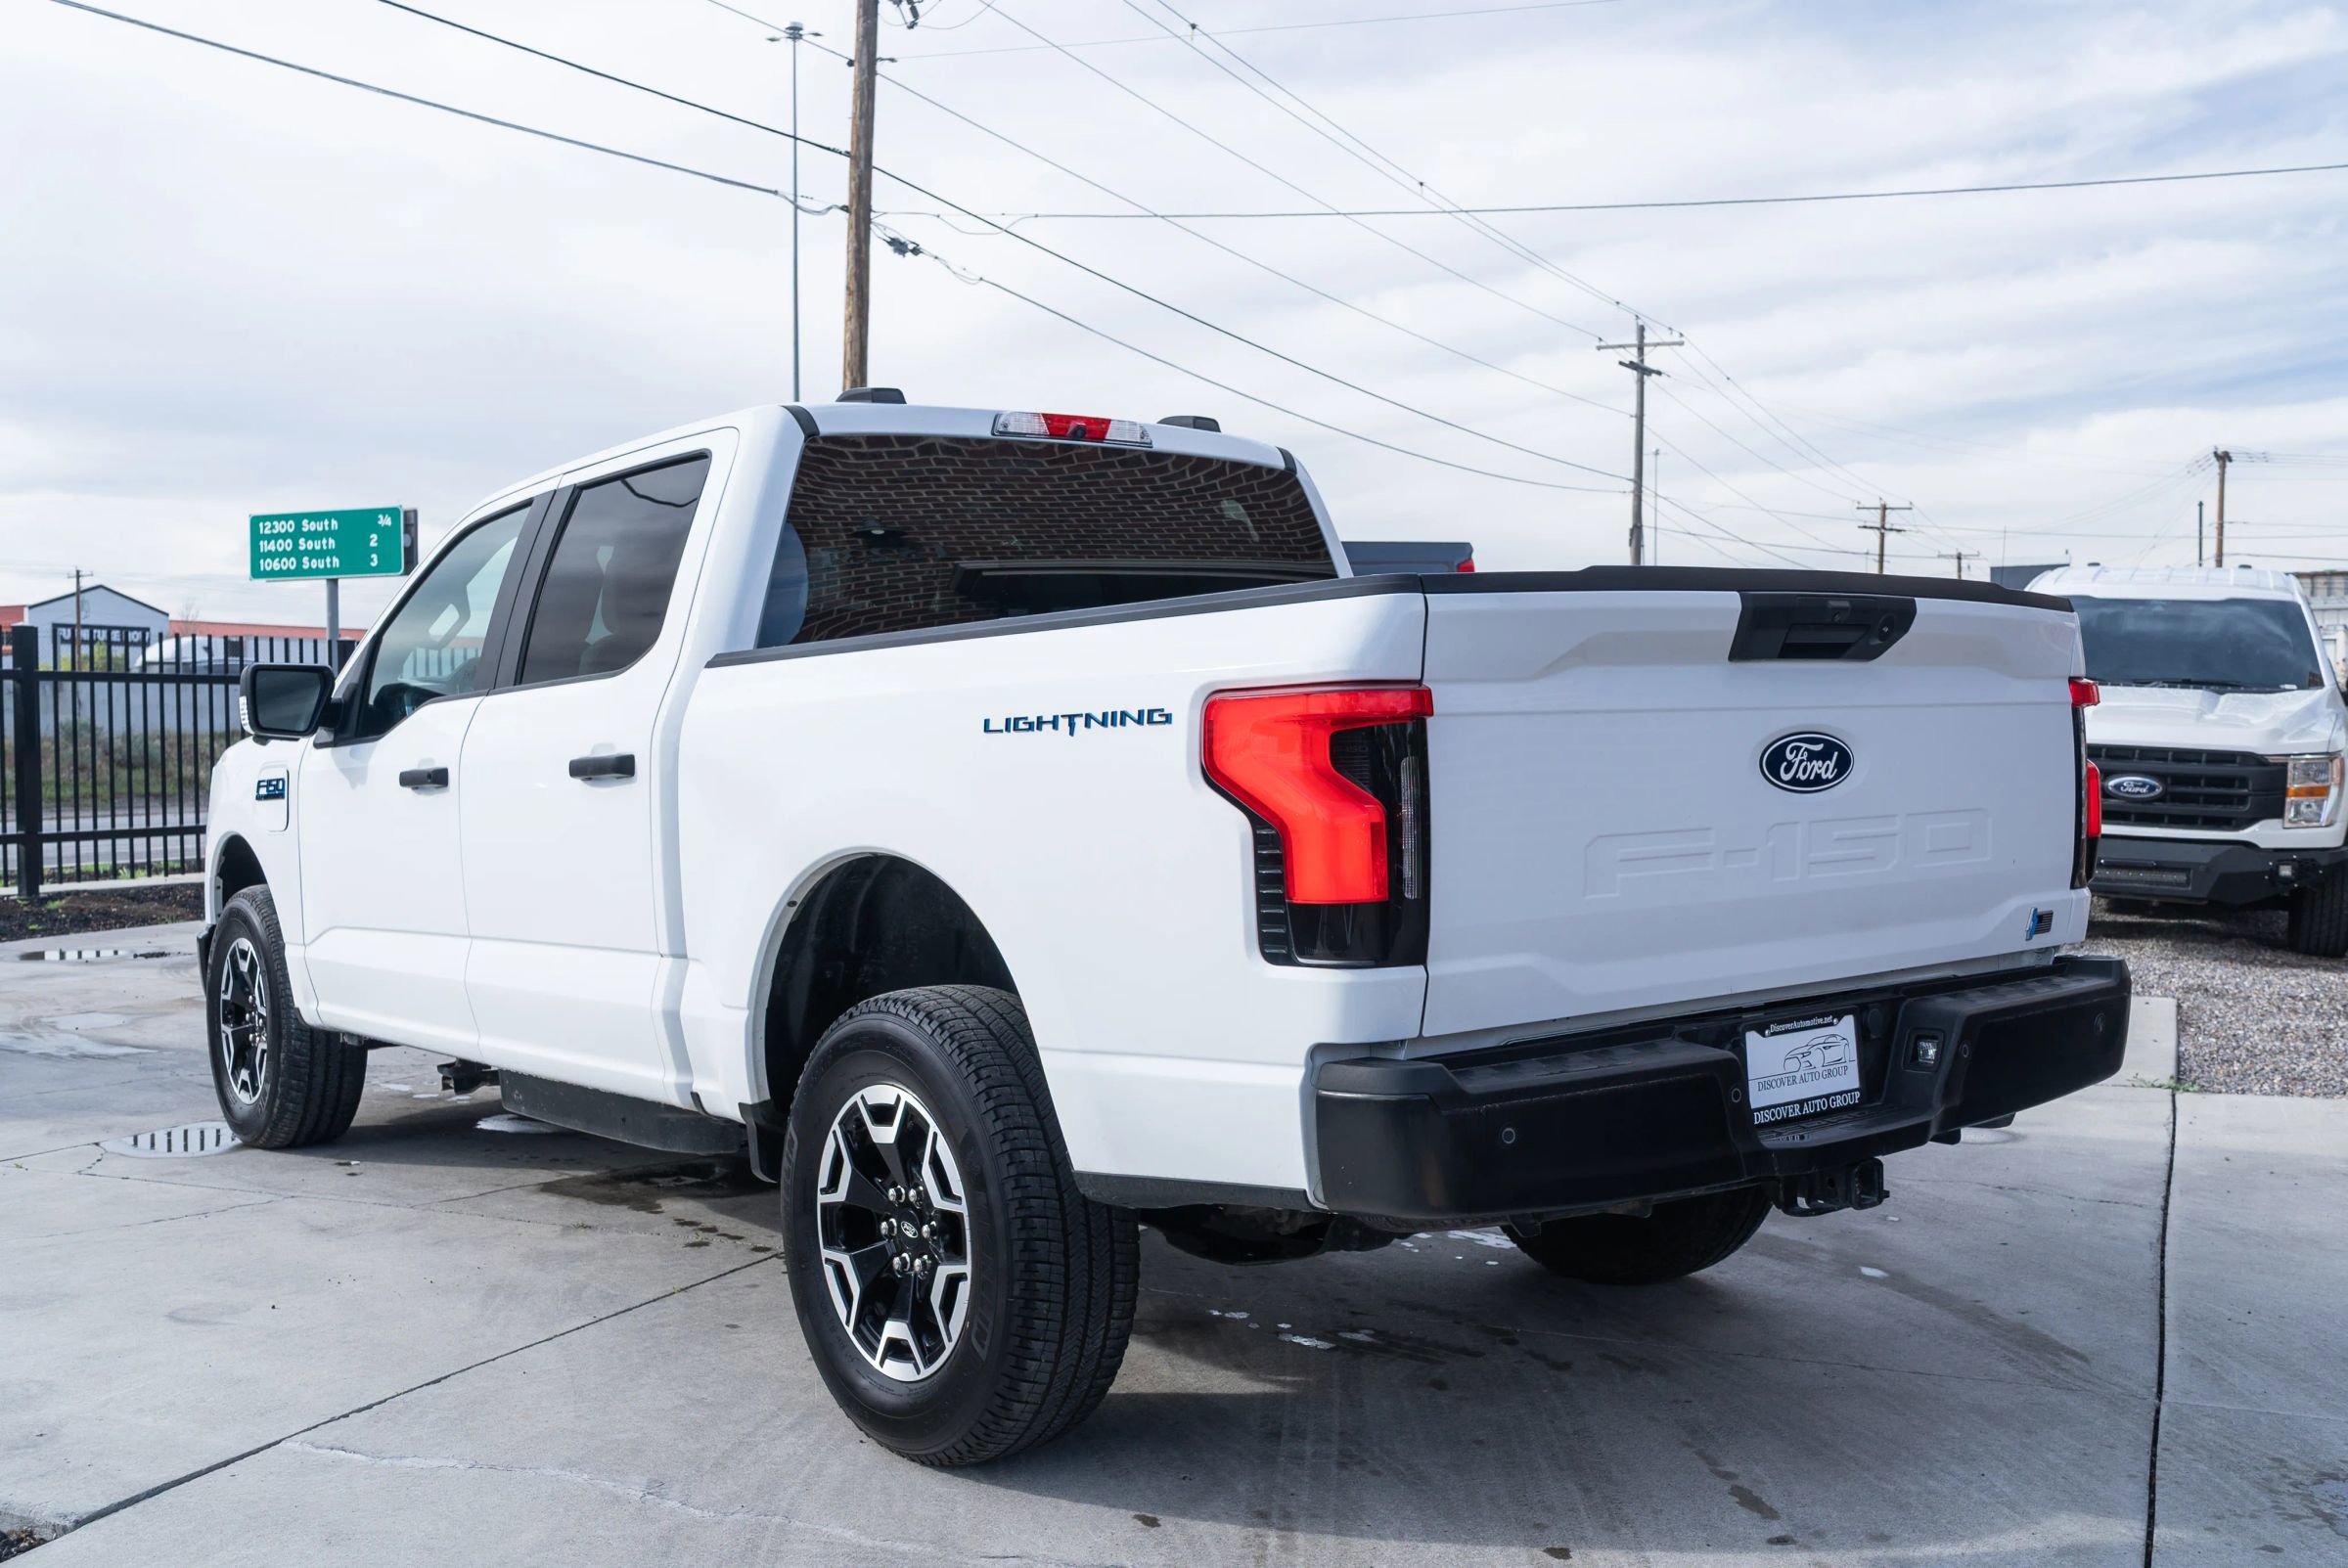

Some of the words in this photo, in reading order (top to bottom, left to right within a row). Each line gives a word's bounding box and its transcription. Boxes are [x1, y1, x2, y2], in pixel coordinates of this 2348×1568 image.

[259, 519, 294, 534] 12300
[301, 517, 339, 532] South
[259, 539, 293, 553] 11400
[298, 537, 336, 551] South
[370, 534, 378, 547] 2
[259, 558, 296, 571] 10600
[302, 556, 339, 569] South
[370, 554, 378, 567] 3
[983, 707, 1173, 737] LIGHTNING
[1780, 741, 1838, 781] Ford
[2120, 781, 2150, 793] Ford
[1583, 808, 1992, 900] F-150
[1770, 1015, 1833, 1033] DiscoverAutomotive.net
[1757, 1075, 1797, 1092] DISCOVER
[1799, 1071, 1820, 1084] AUTO
[1822, 1065, 1849, 1080] GROUP
[1753, 1105, 1801, 1125] DISCOVER
[1802, 1098, 1828, 1115] AUTO
[1829, 1091, 1861, 1108] GROUP
